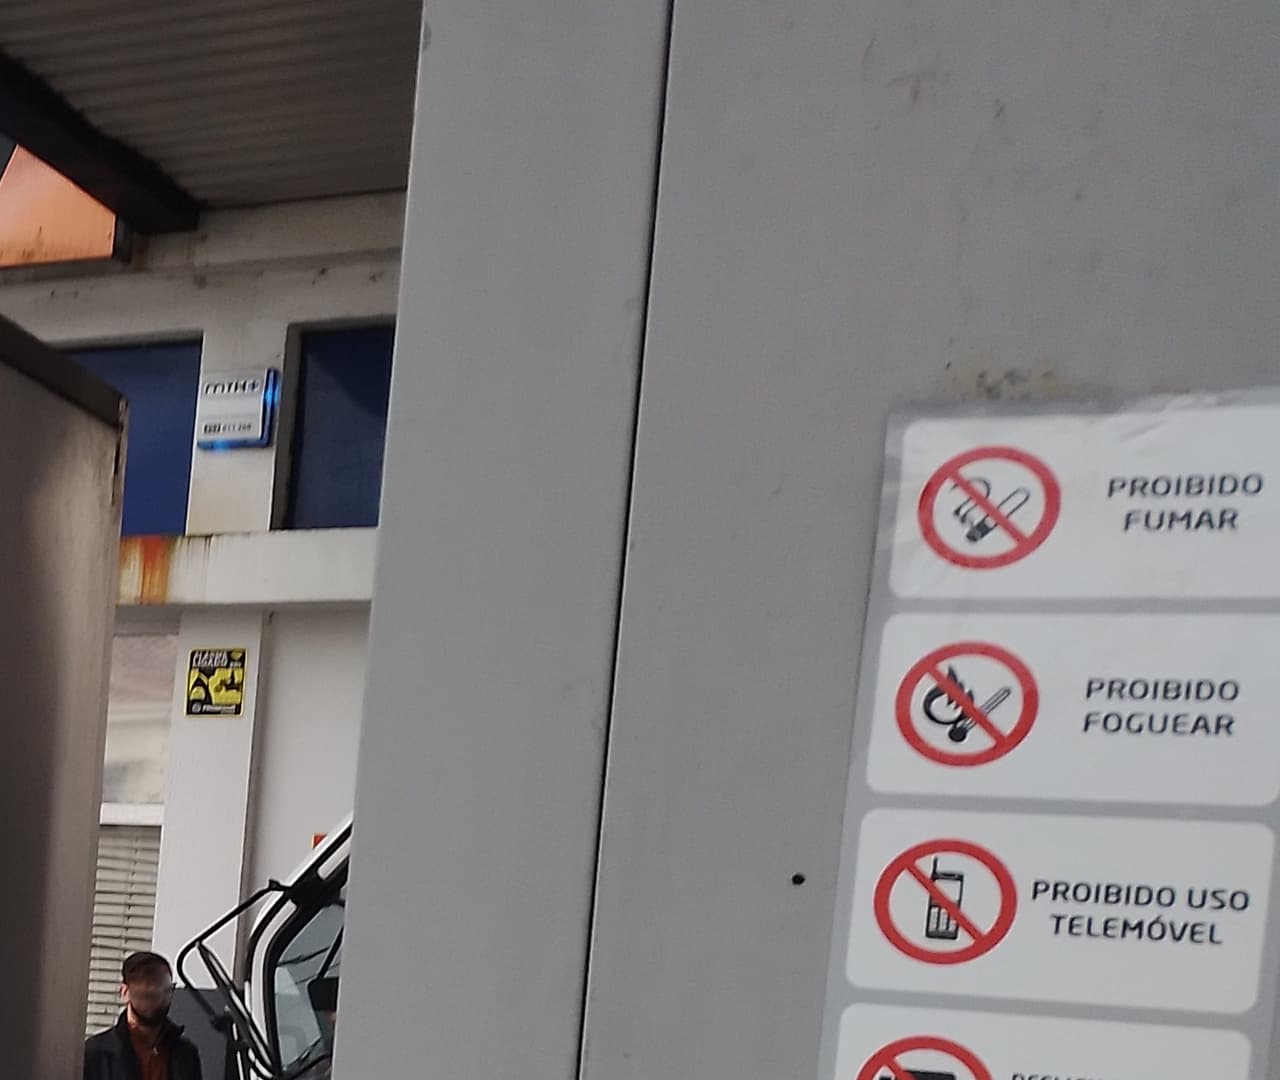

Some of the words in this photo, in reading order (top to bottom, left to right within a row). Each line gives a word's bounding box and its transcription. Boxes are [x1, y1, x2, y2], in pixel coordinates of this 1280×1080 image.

[1107, 474, 1264, 499] PROIBIDO
[1123, 508, 1239, 532] FUMAR
[1085, 679, 1240, 702] PROIBIDO
[1083, 712, 1235, 736] FOGUEAR
[1031, 880, 1176, 908] PROIBIDO
[1187, 888, 1250, 912] USO
[1051, 914, 1222, 945] TELEMÓVEL
